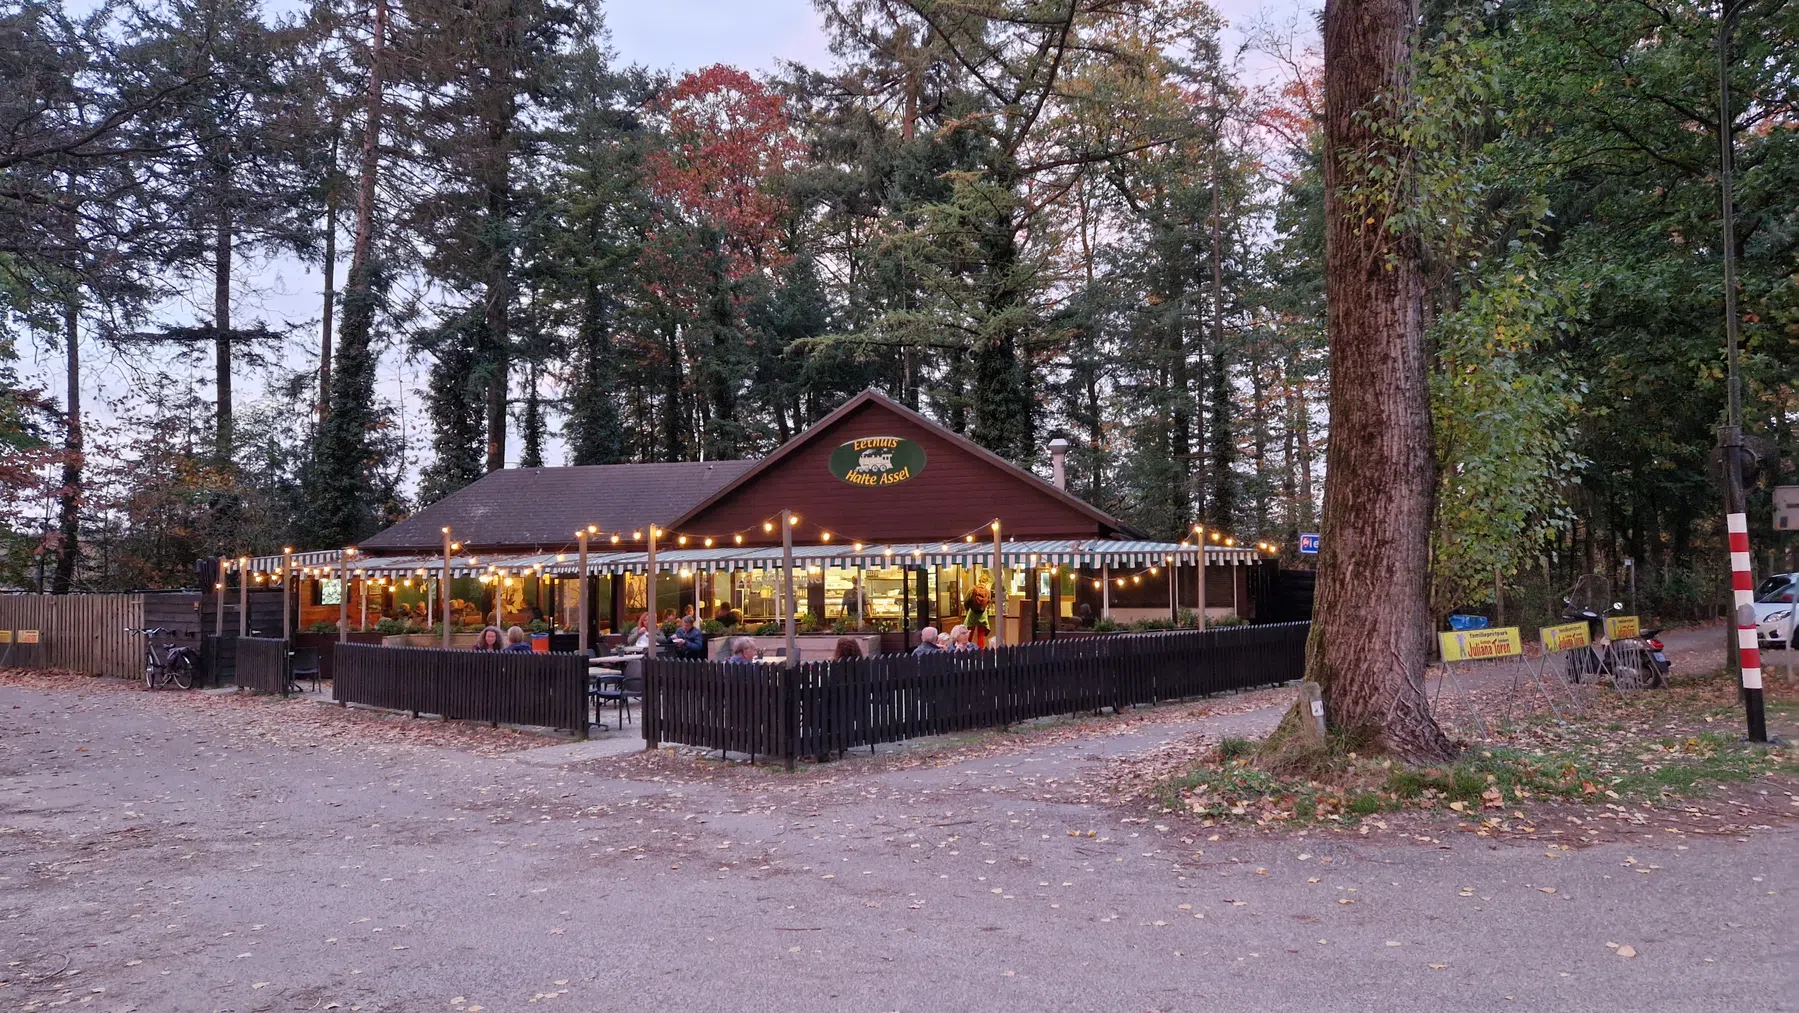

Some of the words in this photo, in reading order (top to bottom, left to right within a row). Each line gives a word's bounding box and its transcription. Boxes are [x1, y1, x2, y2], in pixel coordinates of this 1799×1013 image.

[854, 438, 898, 450] Eethuis
[845, 470, 877, 485] Halte
[879, 466, 910, 485] Assel
[1467, 641, 1493, 658] Juliana
[1492, 639, 1512, 655] Toren
